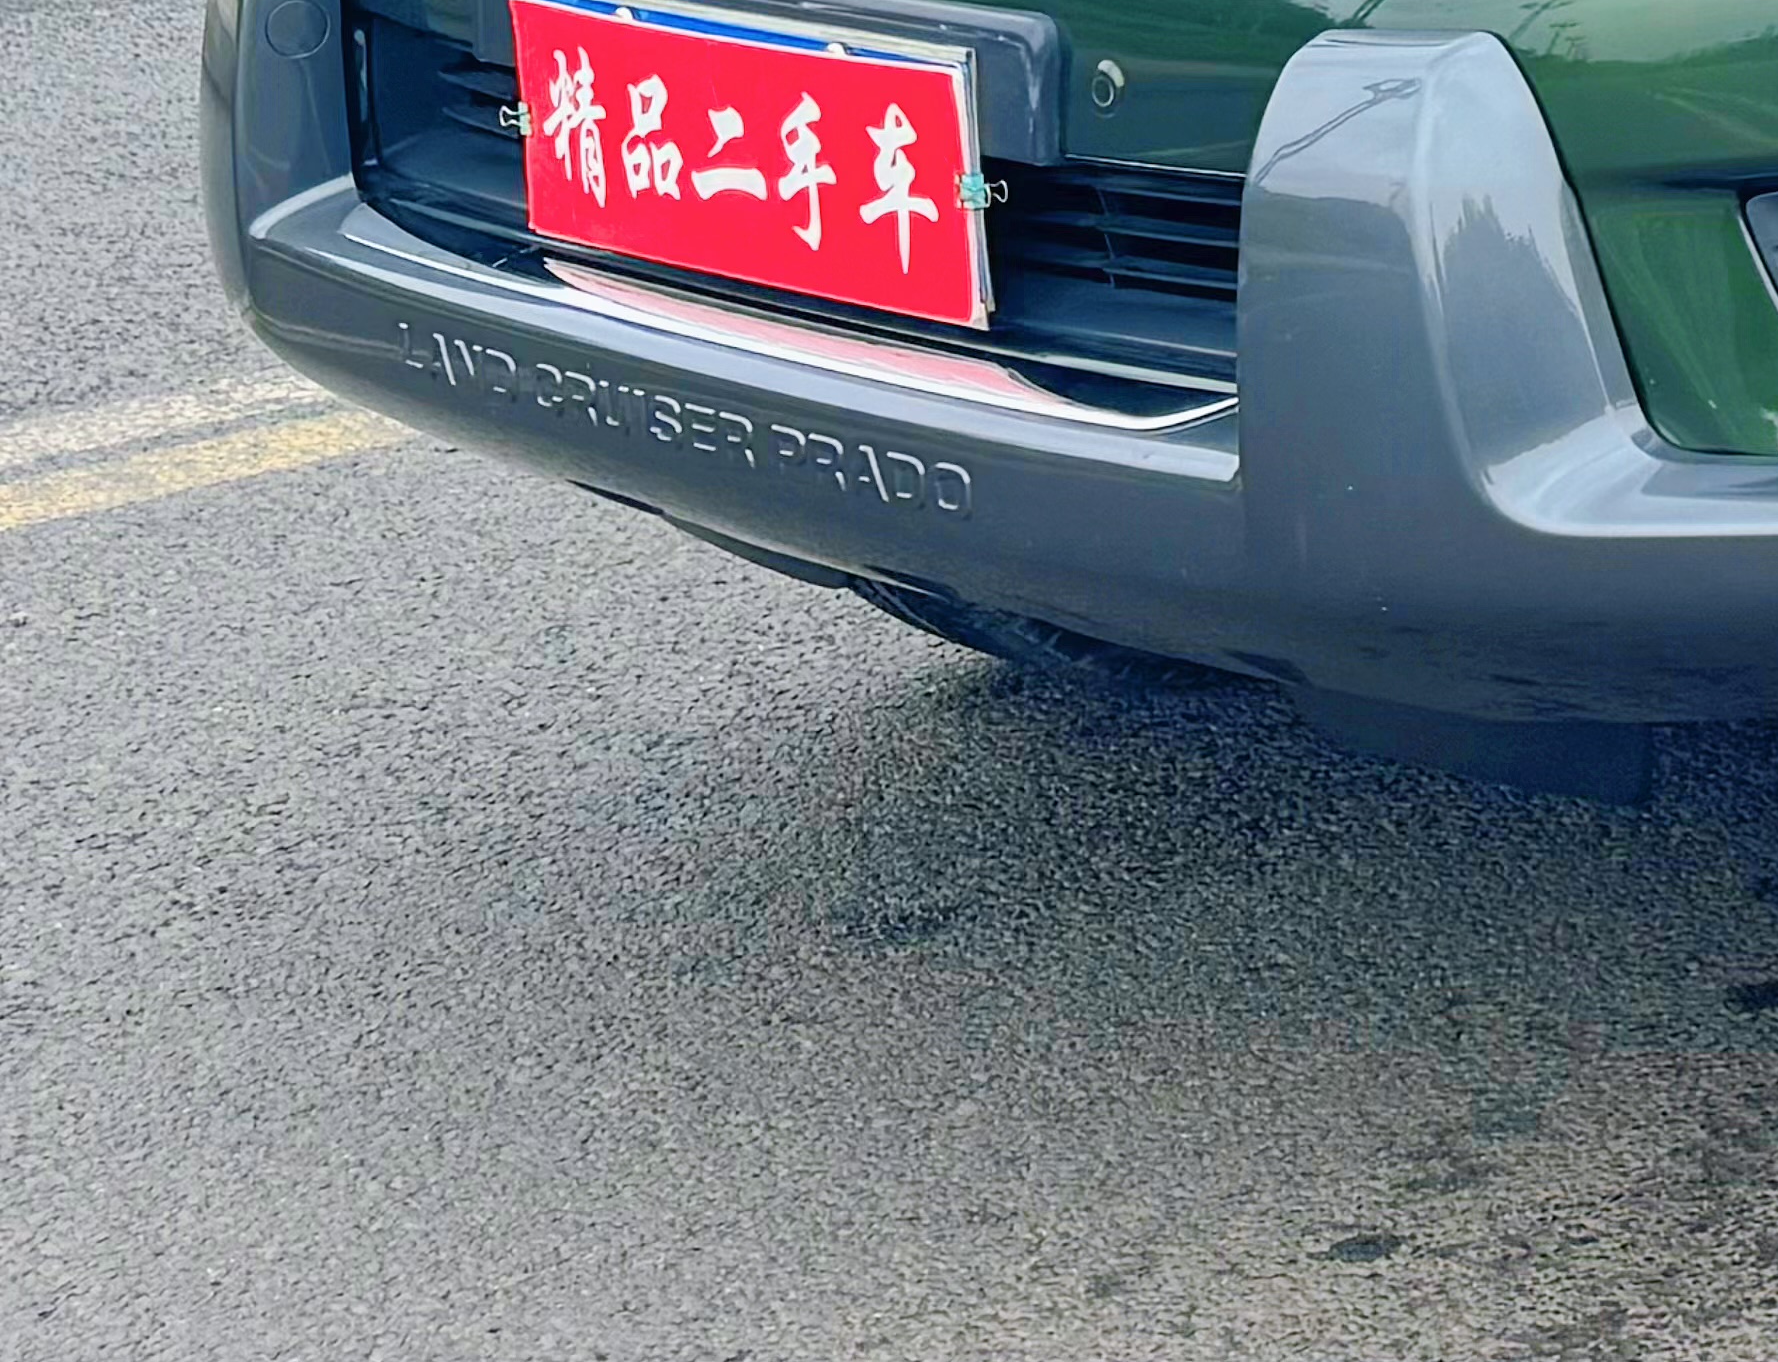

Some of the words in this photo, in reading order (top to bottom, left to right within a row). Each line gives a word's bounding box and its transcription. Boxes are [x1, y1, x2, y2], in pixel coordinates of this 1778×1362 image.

[543, 45, 940, 275] 精品二手车
[399, 321, 518, 401] LAND
[534, 361, 756, 469] CRUISER
[769, 422, 974, 520] PRADO
